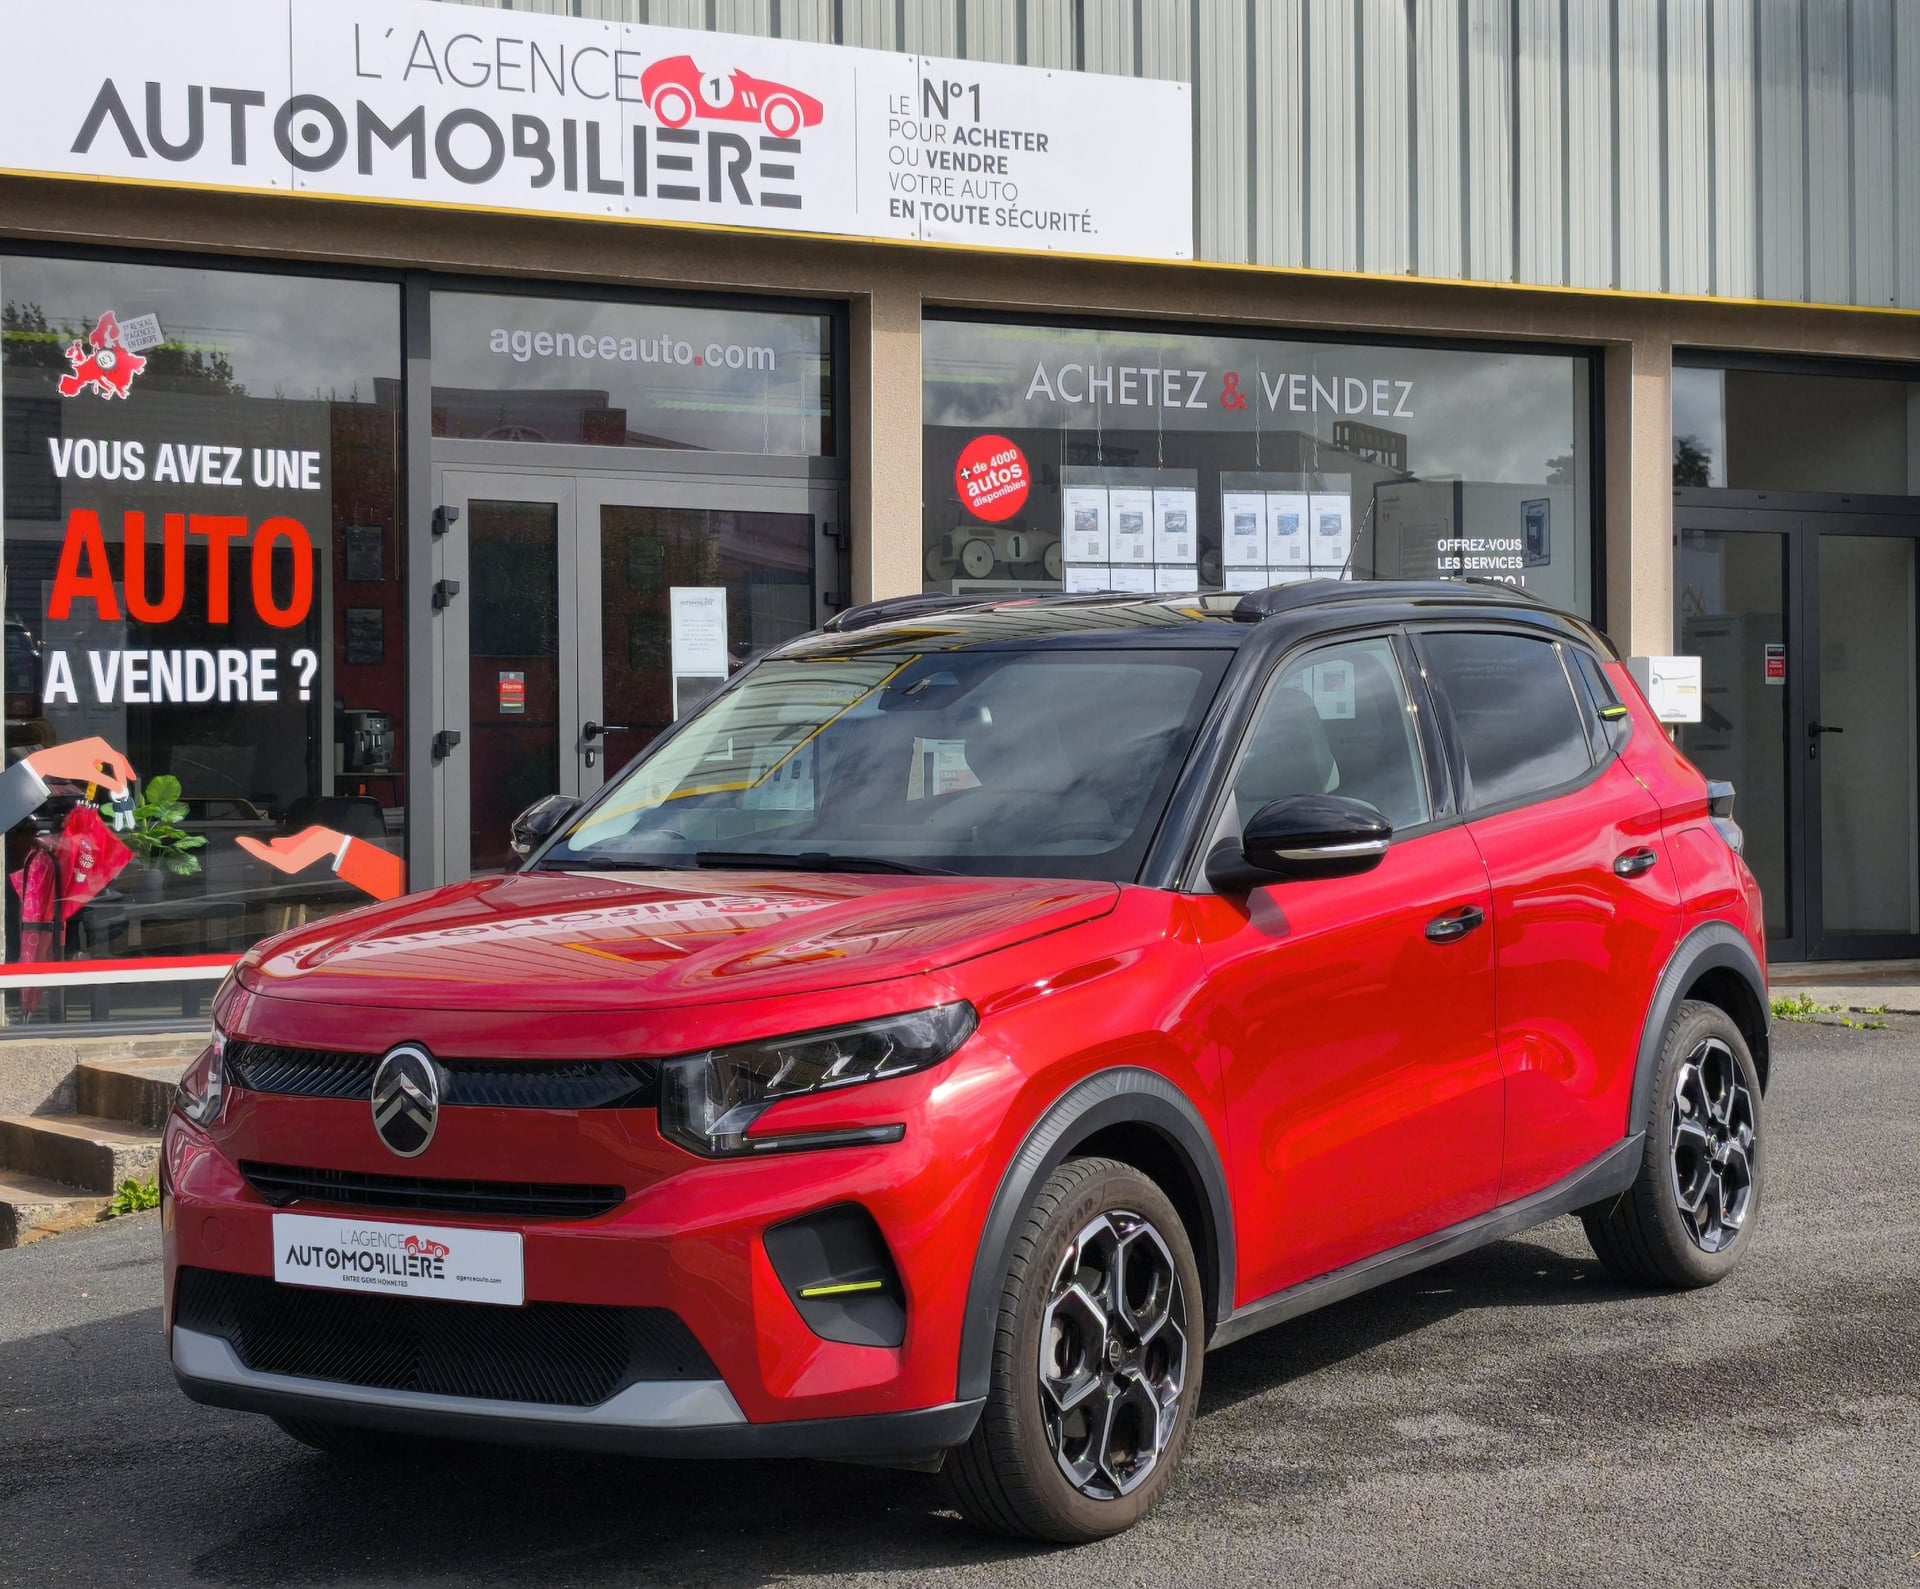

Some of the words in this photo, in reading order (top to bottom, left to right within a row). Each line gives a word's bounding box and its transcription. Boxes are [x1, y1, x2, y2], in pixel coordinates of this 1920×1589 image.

[889, 94, 911, 116] LE
[889, 119, 947, 144] POUR
[952, 126, 1049, 153] ACHETER
[889, 145, 919, 167] OU
[925, 149, 1009, 176] VENDRE
[889, 171, 955, 197] VOTRE
[960, 179, 1019, 202] AUTO
[889, 198, 915, 219] EN
[920, 201, 990, 225] TOUTE
[995, 203, 1099, 234] SÉCURITÉ.
[489, 328, 776, 371] agenceauto.com
[1024, 361, 1208, 408] ACHETEZ
[1220, 371, 1247, 411] &
[1259, 371, 1415, 418] VENDEZ
[48, 437, 145, 481] VOUS
[154, 443, 243, 486] AVEZ
[253, 448, 321, 489] UNE
[973, 462, 988, 474] de
[990, 449, 1017, 468] 4000
[967, 463, 1023, 497] autos
[973, 479, 1027, 508] disponibles
[1437, 539, 1523, 552] OFFREZ-VOUS
[47, 508, 314, 628] AUTO
[1437, 556, 1461, 570] LES
[1464, 556, 1523, 570] SERVICES
[43, 650, 79, 703] A
[88, 649, 278, 703] VENDRE
